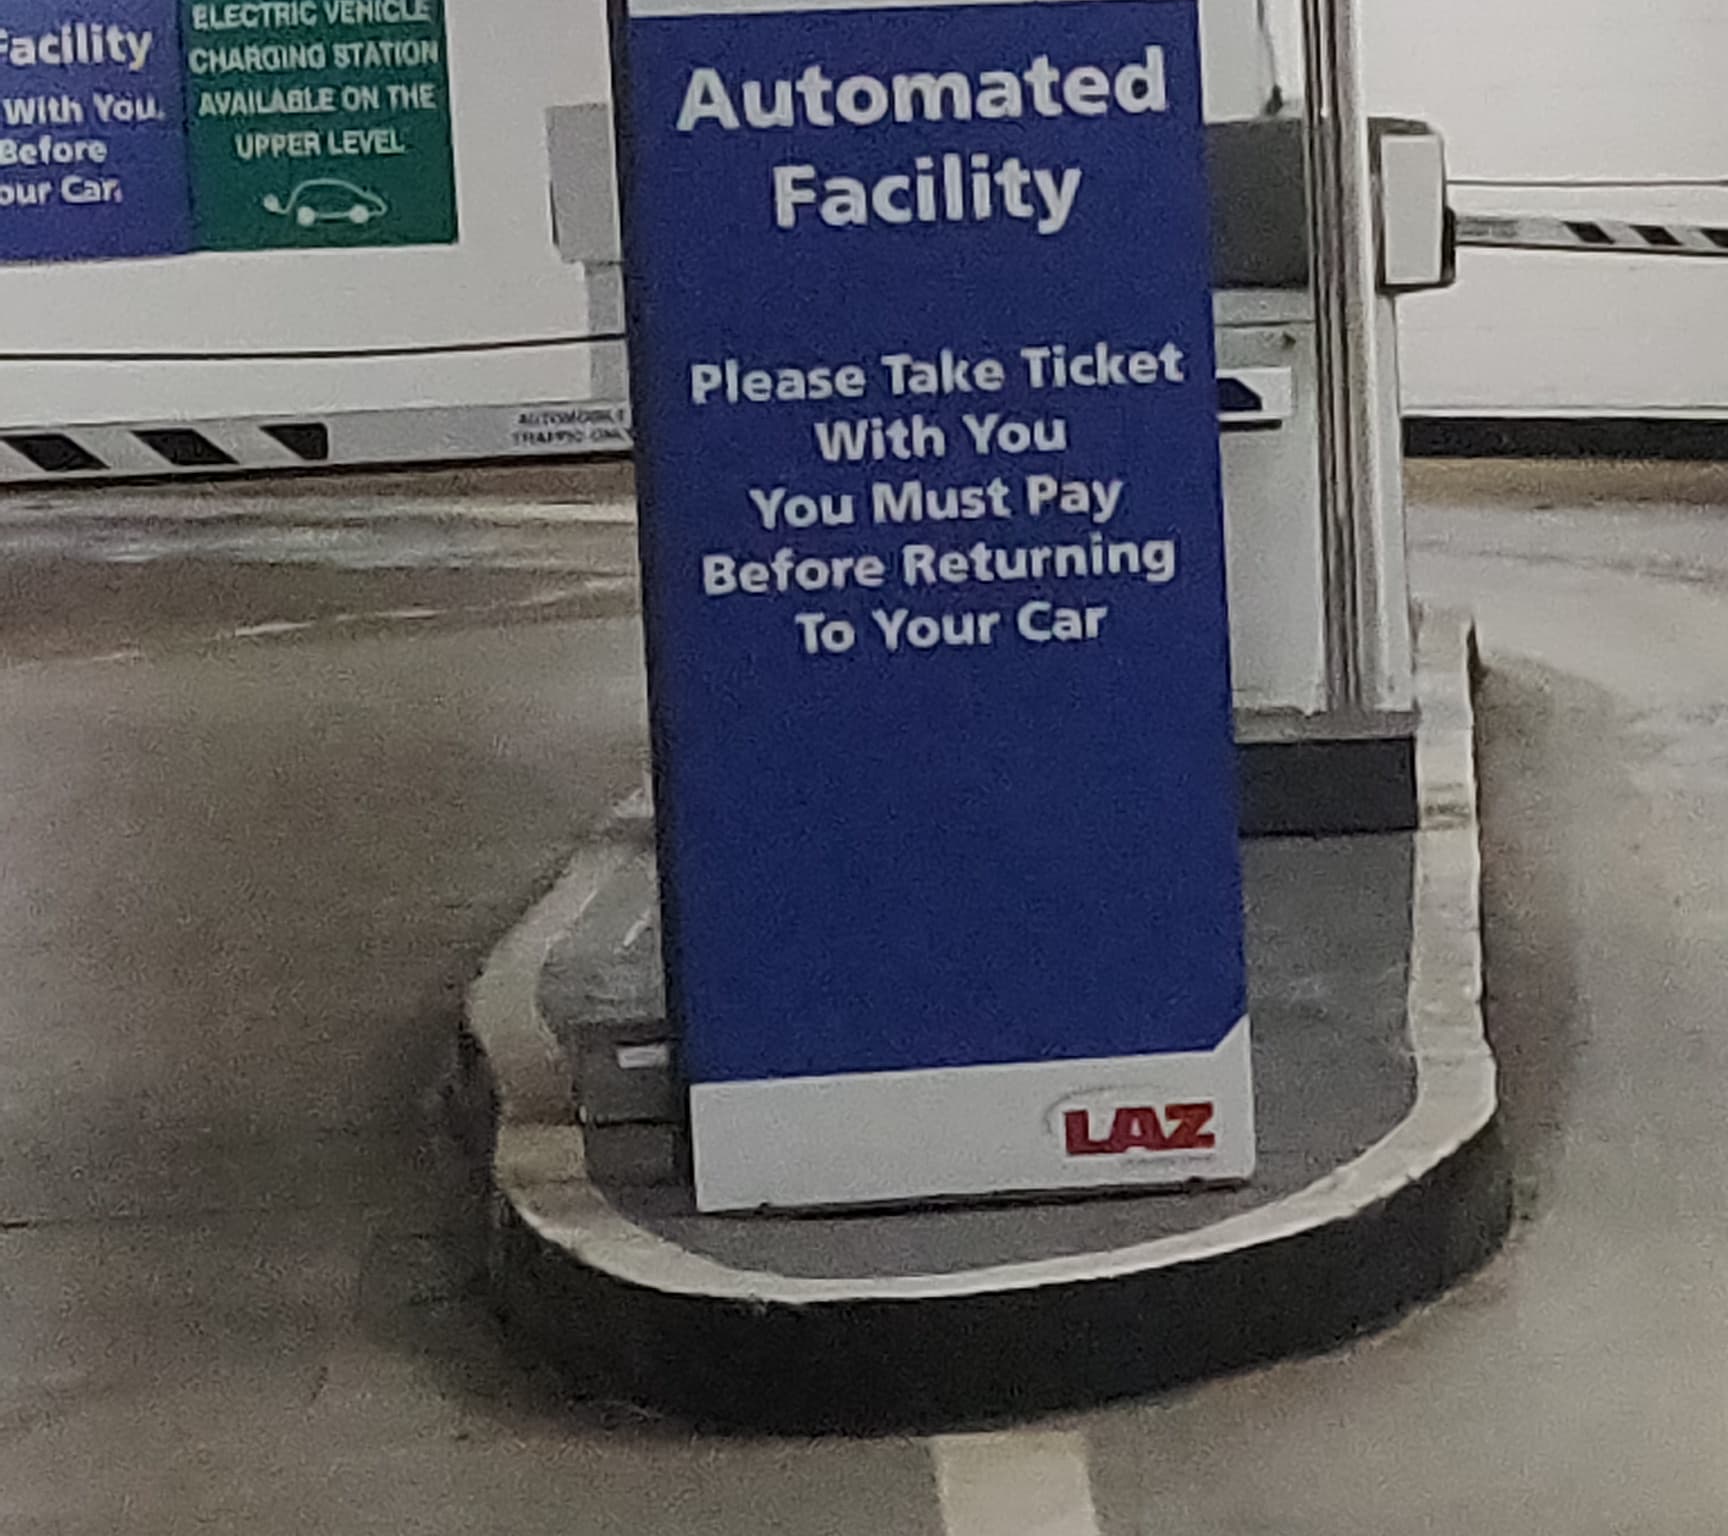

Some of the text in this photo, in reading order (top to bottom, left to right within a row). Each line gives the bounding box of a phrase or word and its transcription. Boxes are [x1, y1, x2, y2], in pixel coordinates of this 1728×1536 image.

[192, 0, 318, 30] ELECTRIC
[188, 40, 439, 74] CHARGING STATION
[2, 92, 167, 125] With You.
[199, 83, 437, 116] AVAILABLE ON THE
[676, 45, 1167, 131] Automated
[0, 135, 107, 165] Before
[234, 126, 406, 160] UPPER LEVEL
[773, 153, 1082, 234] Facility
[690, 342, 1185, 404] Please Take Ticket
[814, 413, 1067, 462] With You
[749, 474, 1123, 530] You Must Pay
[702, 533, 1176, 596] Before Returning
[795, 600, 1108, 655] To Your Car
[1063, 1102, 1215, 1156] LAZ
